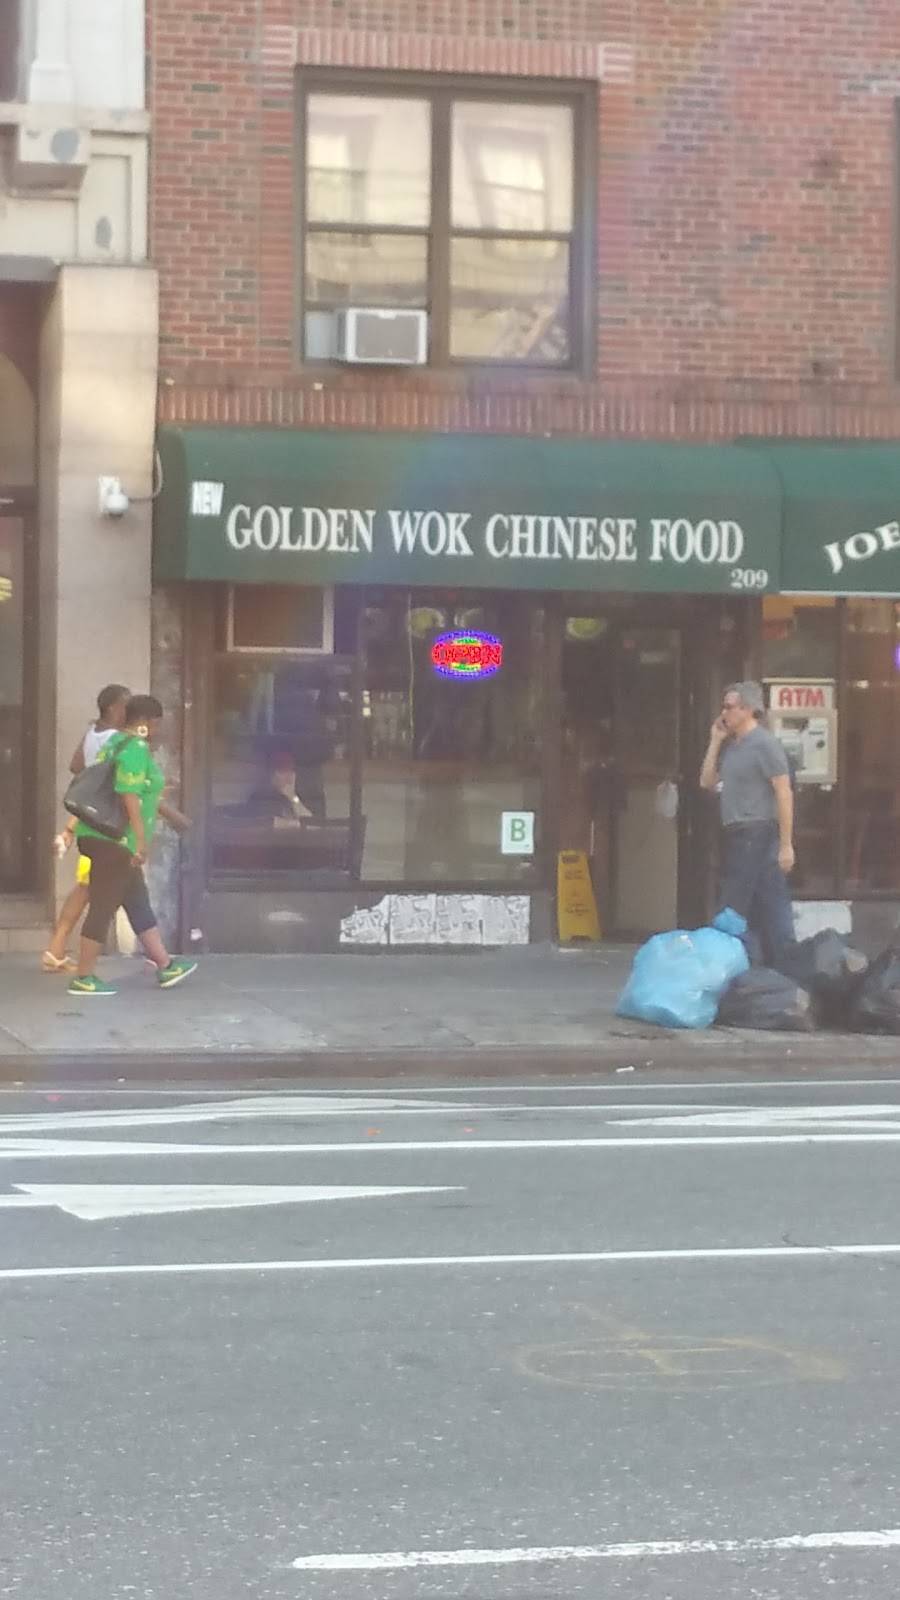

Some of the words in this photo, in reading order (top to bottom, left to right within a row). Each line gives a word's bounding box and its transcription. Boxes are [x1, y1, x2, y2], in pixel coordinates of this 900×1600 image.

[191, 481, 224, 516] NEW
[226, 504, 376, 552] GOLDEN
[388, 510, 474, 557] WOK
[485, 513, 638, 561] CHINESE
[650, 518, 745, 564] FOOD
[730, 568, 769, 589] 209
[431, 642, 504, 666] OPEN
[778, 687, 827, 708] ATM
[510, 818, 527, 842] B
